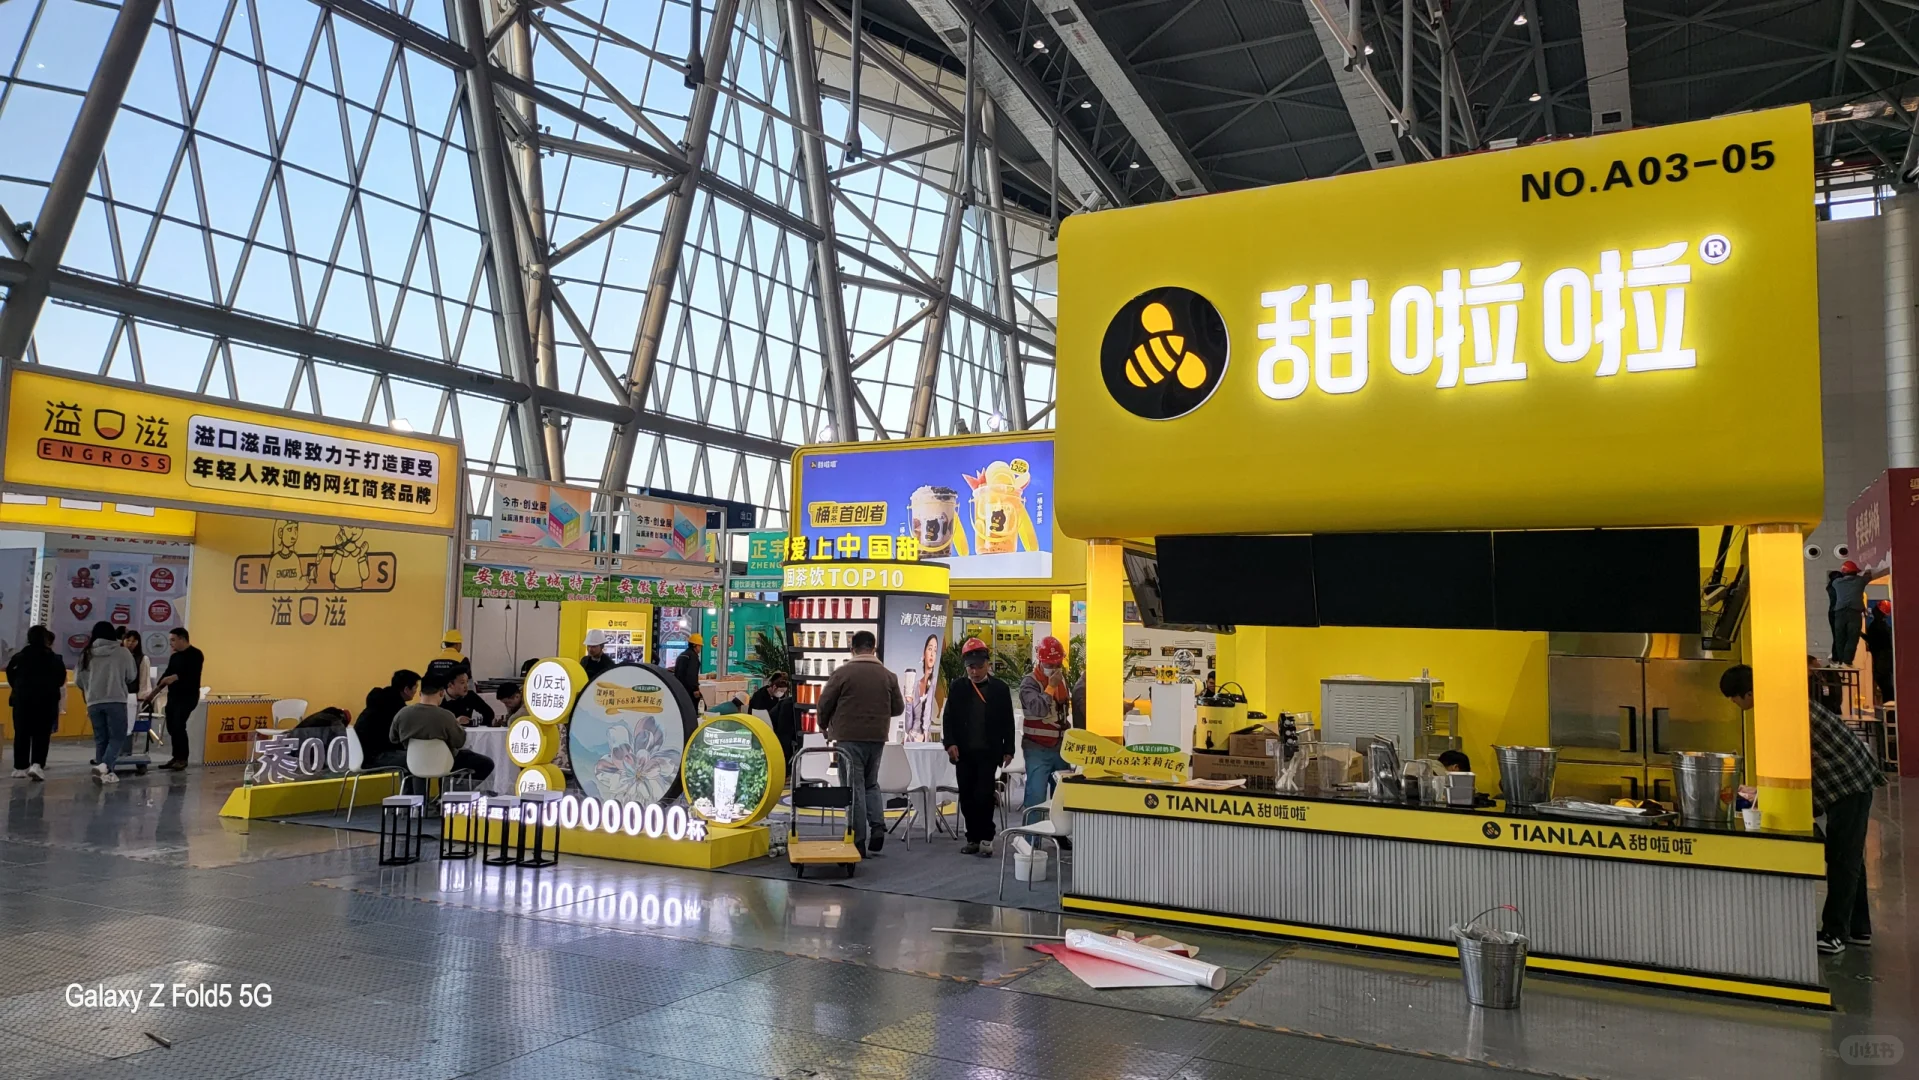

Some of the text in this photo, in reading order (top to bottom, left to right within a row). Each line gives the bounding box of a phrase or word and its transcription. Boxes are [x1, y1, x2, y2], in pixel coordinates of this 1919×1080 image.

[1521, 139, 1776, 203] NO.A03-05
[1257, 240, 1698, 401] 甜啦啦
[44, 400, 169, 448] 溢口滋
[43, 443, 166, 470] ENGROSS
[195, 424, 433, 478] 溢口滋品牌致力于打造更受
[192, 456, 432, 506] 年轻人欢迎的网红简餐品牌
[473, 567, 605, 593] 安徽蒙城特产
[617, 578, 720, 600] 安徽蒙城特产
[271, 596, 348, 626] 溢口滋
[533, 674, 566, 691] 0反式
[531, 692, 565, 709] 脂肪酸
[521, 726, 530, 739] 0
[511, 742, 538, 754] 植脂末
[1064, 740, 1098, 756] 深呼吸
[1075, 755, 1186, 773] 一口喝下68朵茉莉花香
[1166, 794, 1306, 821] TIANLALA 甜啦啦
[1510, 823, 1694, 856] TIANLALA 甜啦啦
